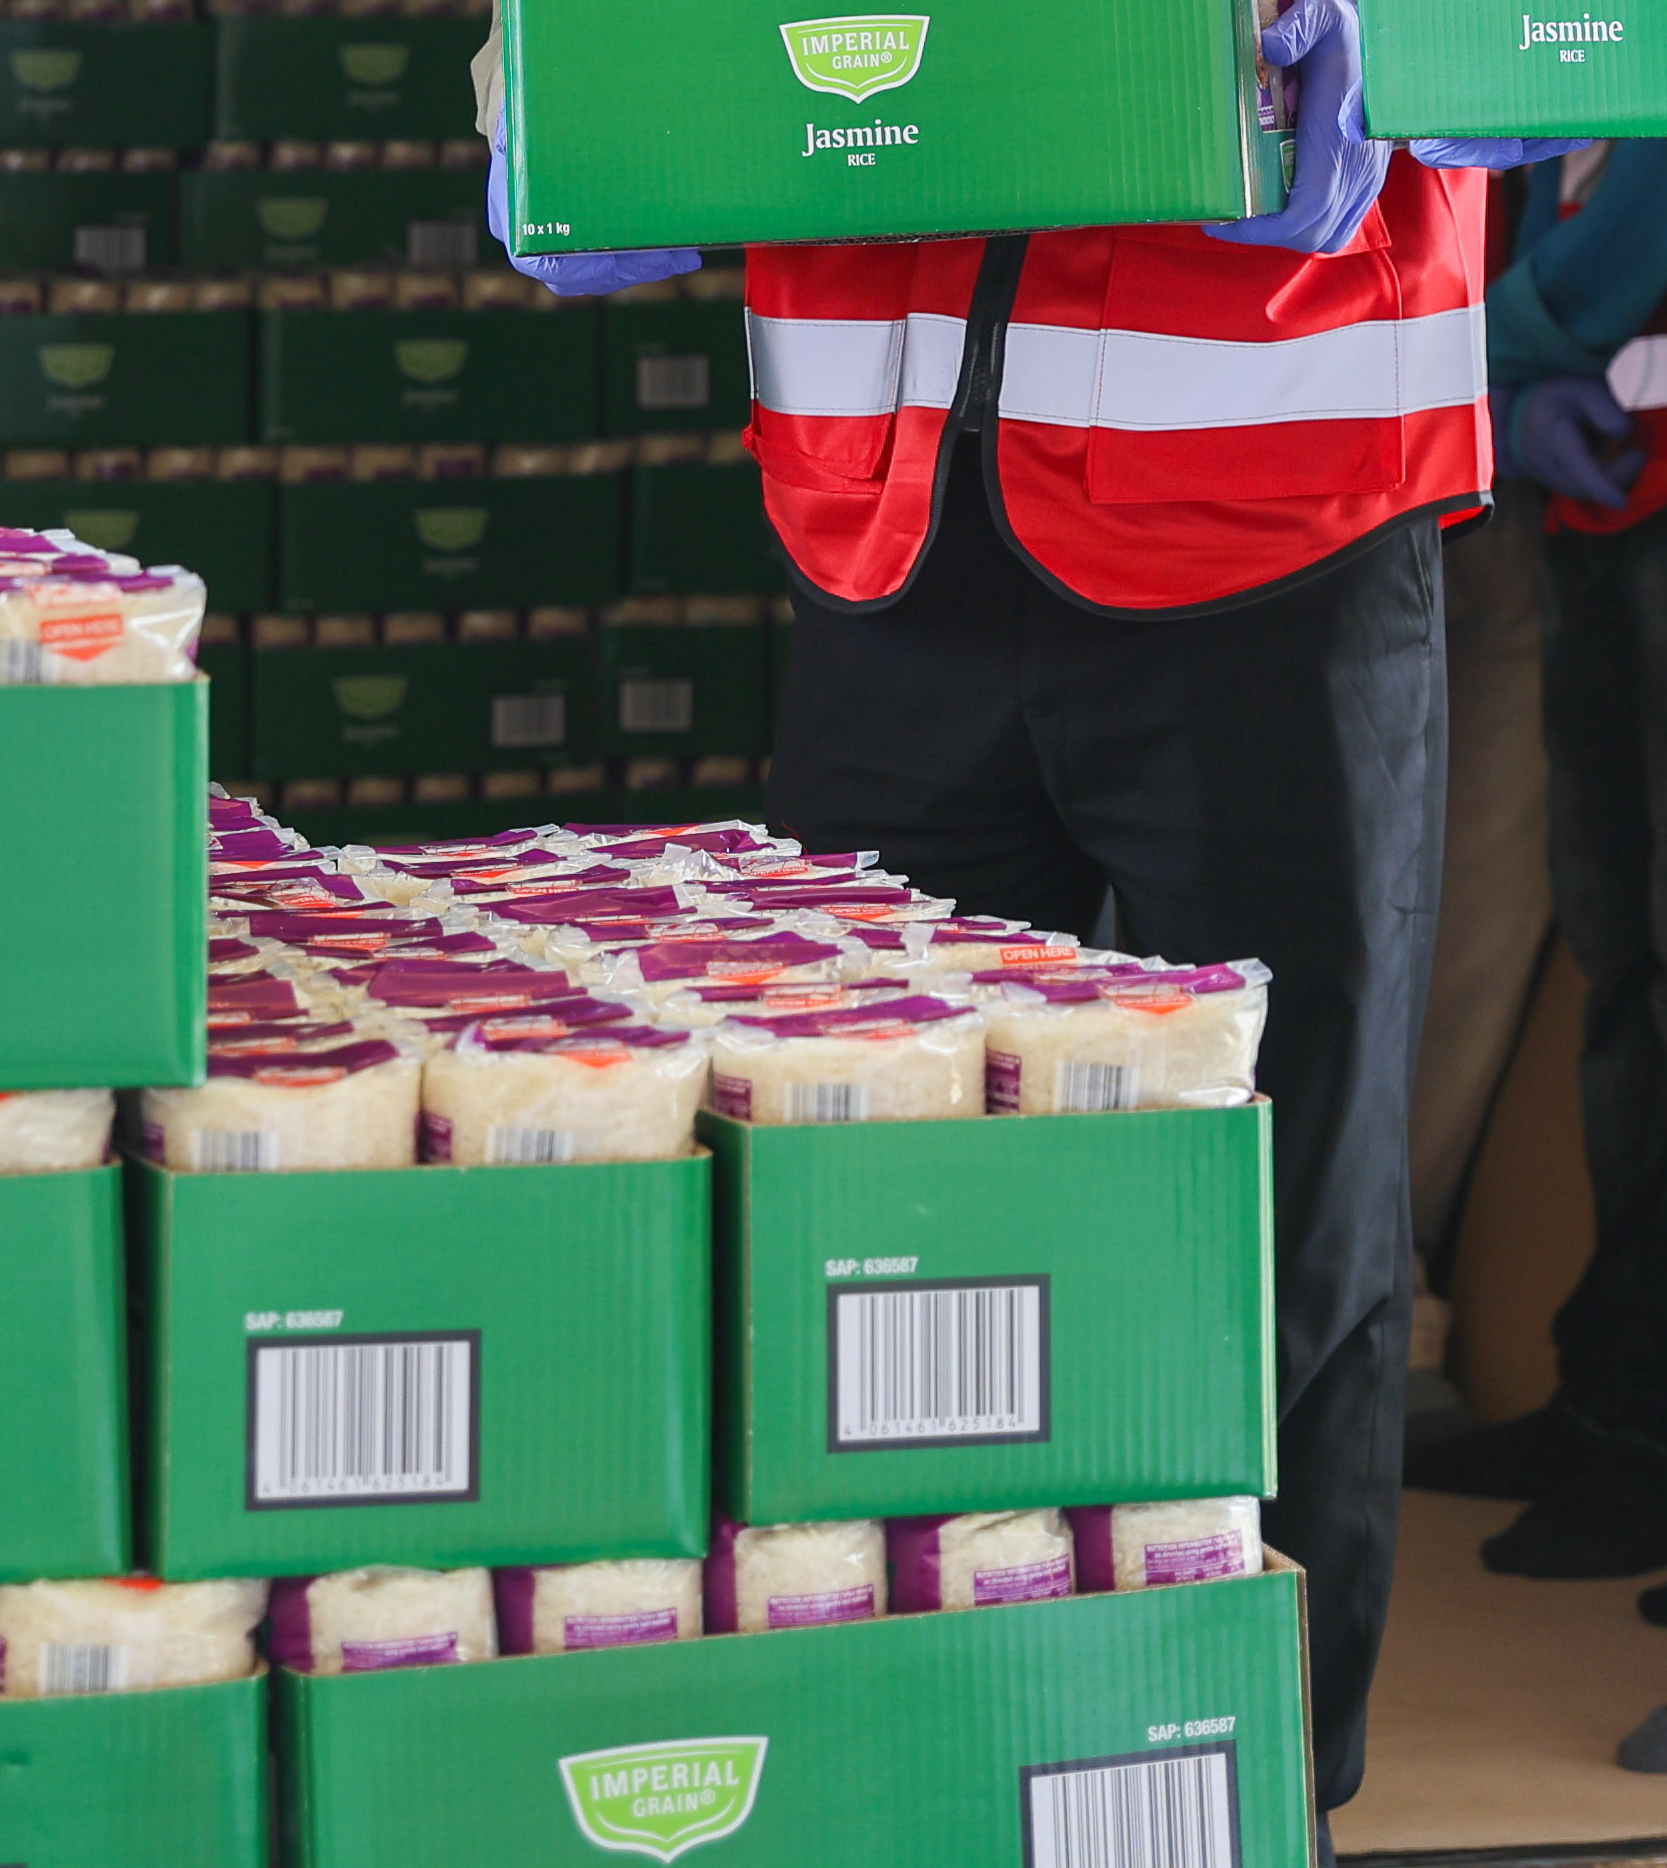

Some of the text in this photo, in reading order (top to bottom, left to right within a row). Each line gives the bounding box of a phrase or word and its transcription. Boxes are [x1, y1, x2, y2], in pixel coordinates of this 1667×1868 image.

[1519, 13, 1624, 51] Jasmine
[801, 30, 910, 56] IMPERIAL
[1559, 49, 1586, 63] RICE
[801, 118, 920, 157] Jasmine
[847, 153, 876, 166] RICE
[522, 221, 571, 237] 10 x 1 kg
[1003, 945, 1075, 962] OPEN HERE
[825, 1256, 919, 1277] SAP: 636587
[244, 1311, 281, 1332] SAP:
[1147, 1715, 1237, 1742] SAP: 636587
[590, 1759, 741, 1801] IMPERIAL
